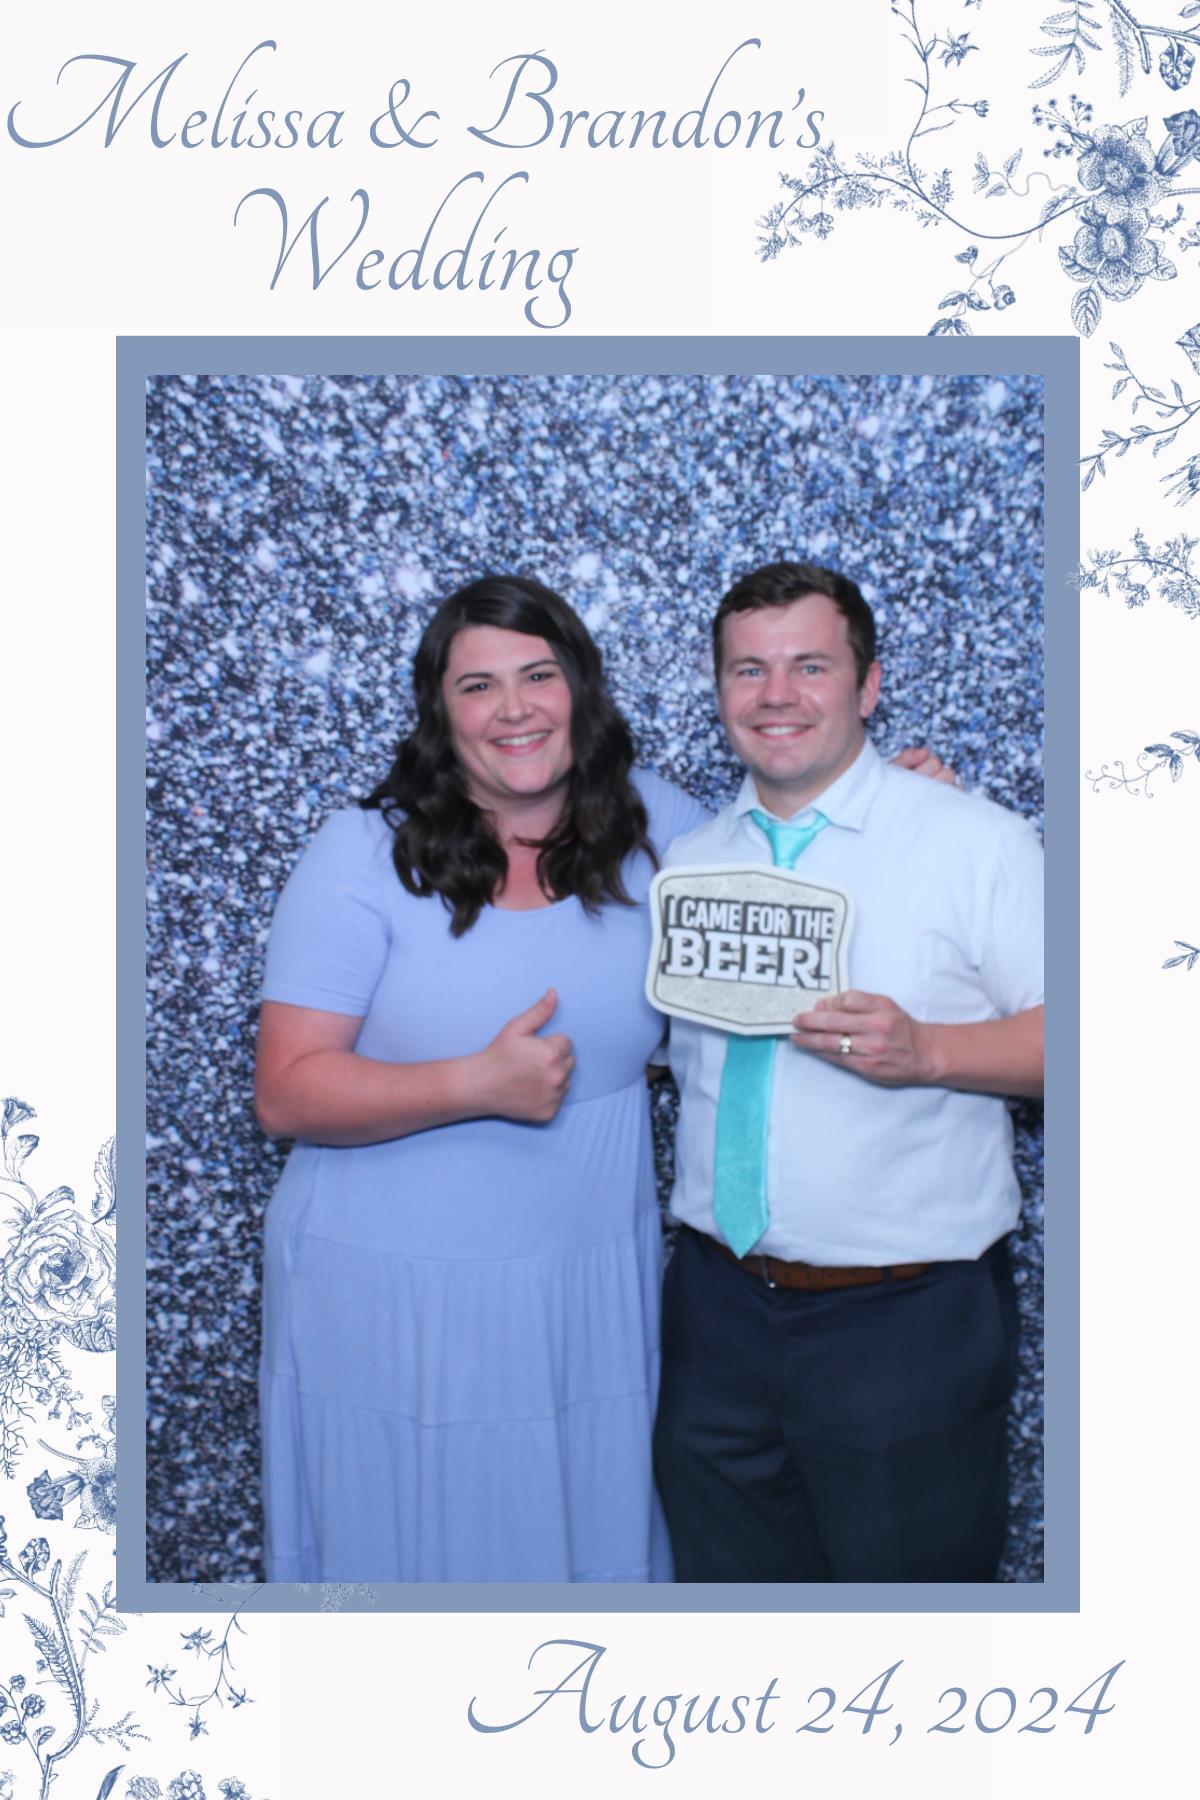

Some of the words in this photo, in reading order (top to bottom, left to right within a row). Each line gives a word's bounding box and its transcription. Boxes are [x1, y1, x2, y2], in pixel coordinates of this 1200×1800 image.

[665, 895, 677, 927] I
[679, 896, 742, 932] CAME
[745, 902, 791, 937] FOR
[791, 905, 834, 941] THE
[662, 927, 833, 991] BEER!
